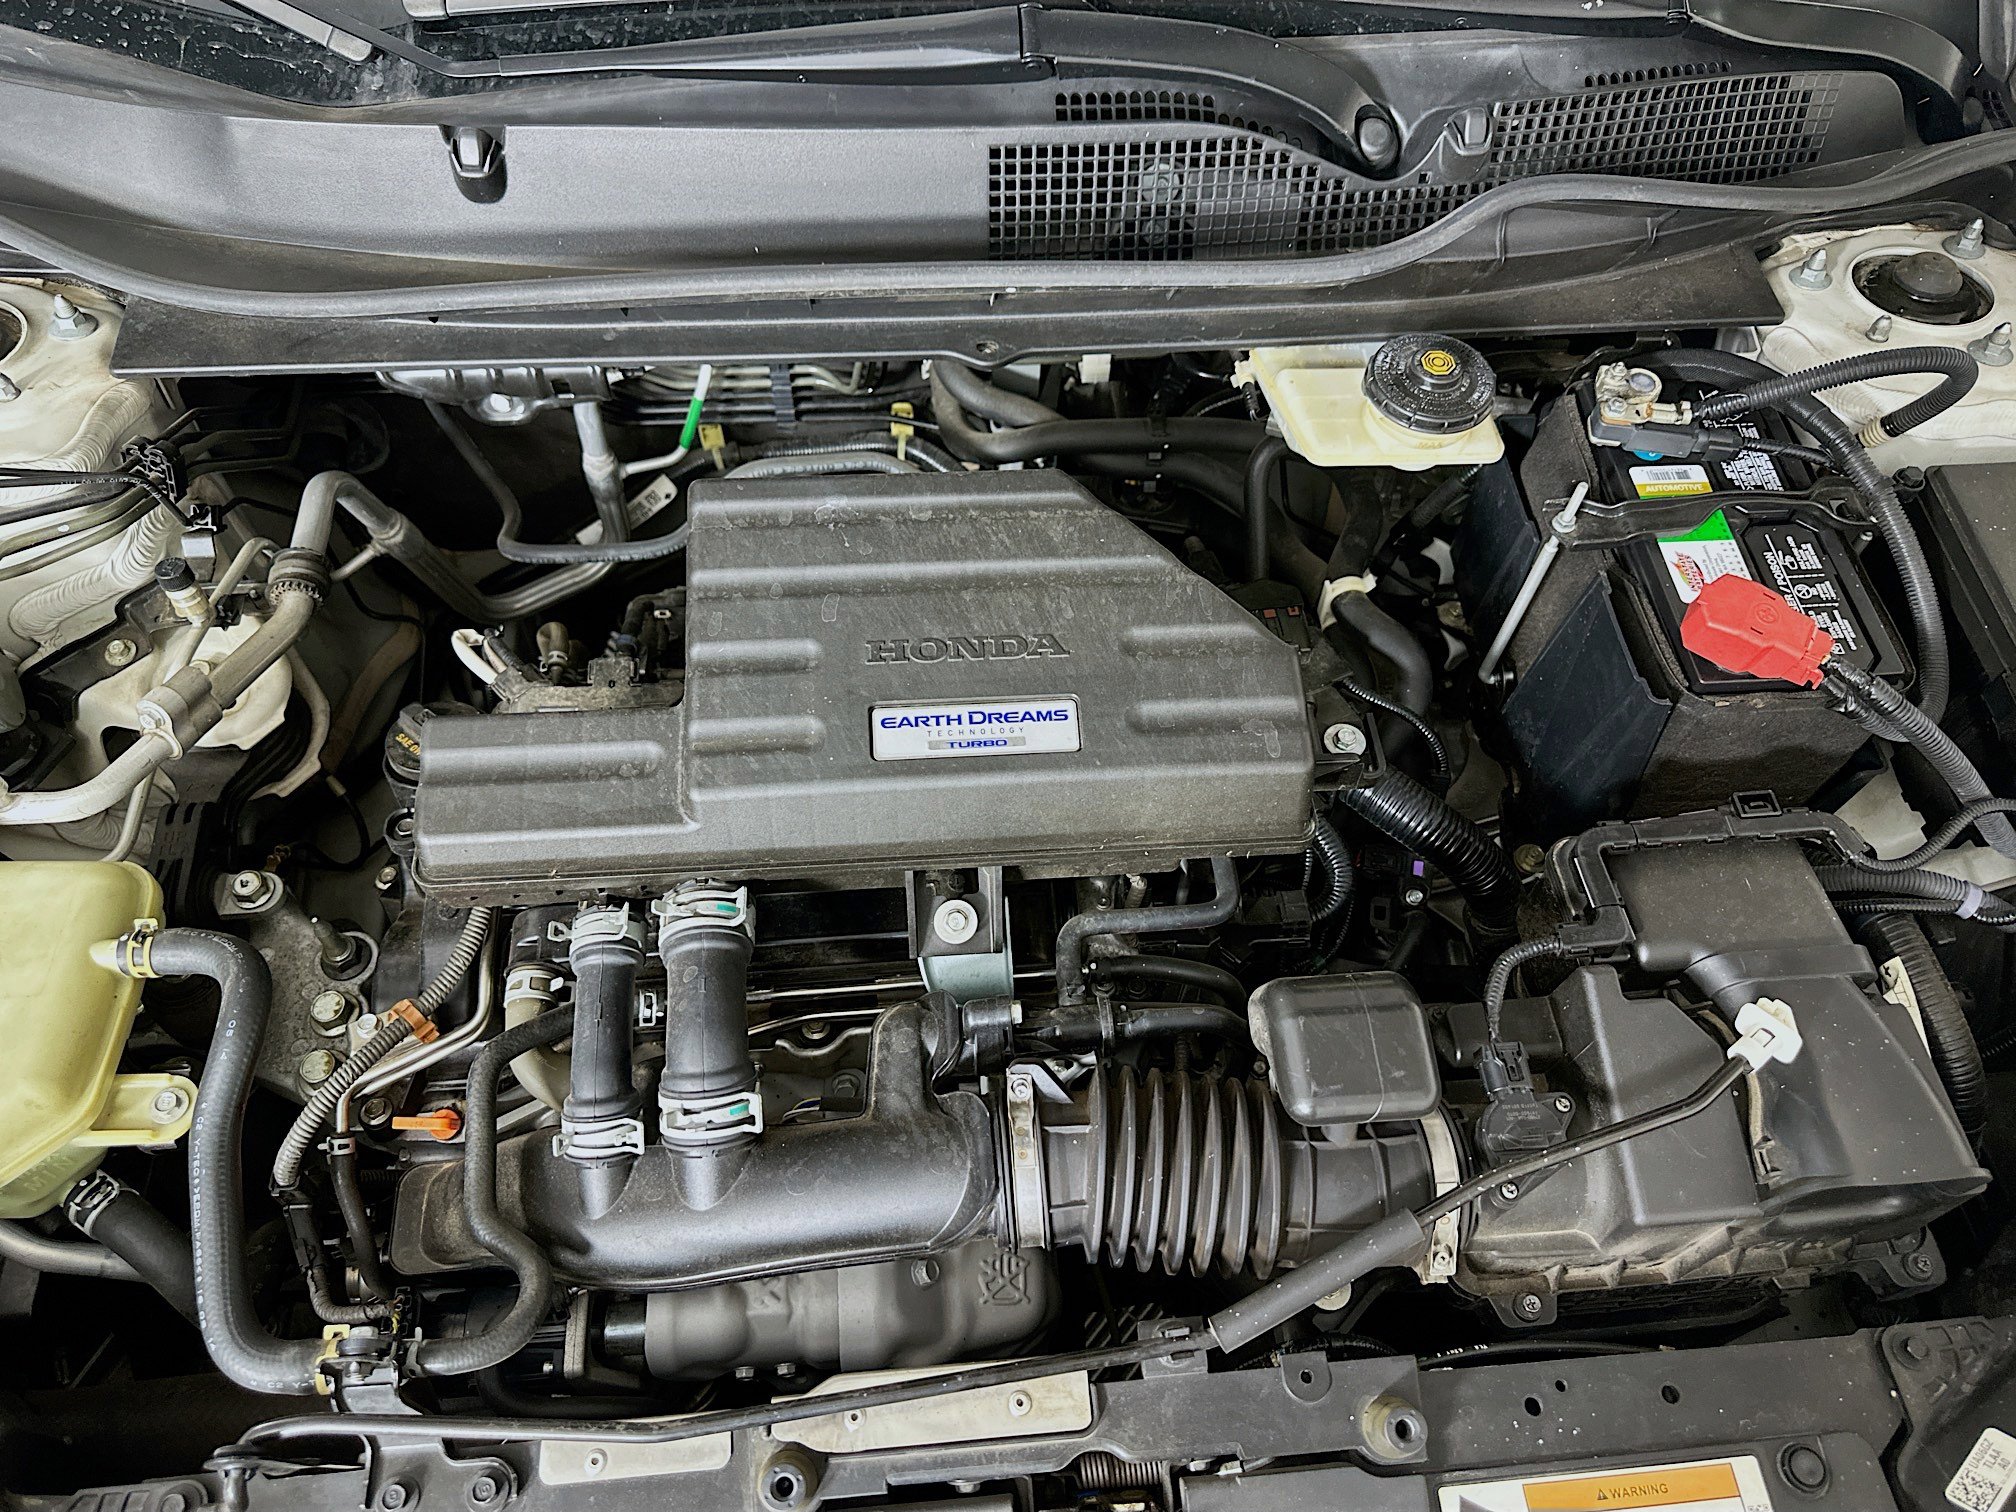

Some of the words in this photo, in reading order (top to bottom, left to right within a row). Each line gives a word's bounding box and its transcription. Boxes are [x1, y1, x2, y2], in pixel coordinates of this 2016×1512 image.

[1645, 483, 1704, 493] AUTOMOTIVE
[1677, 551, 1699, 592] INTERSTATE
[1684, 553, 1703, 590] BATTERIES
[1763, 551, 1788, 587] POISON
[865, 634, 1071, 665] HONDA
[880, 713, 962, 729] EARTH
[395, 732, 415, 748] SAE
[927, 727, 1025, 737] TECHNOLOGY
[949, 739, 1008, 749] TURBO
[195, 1116, 205, 1131] C2
[266, 1381, 285, 1389] C2
[1983, 1449, 2003, 1469] TLAA
[1608, 1483, 1669, 1499] WARNING
